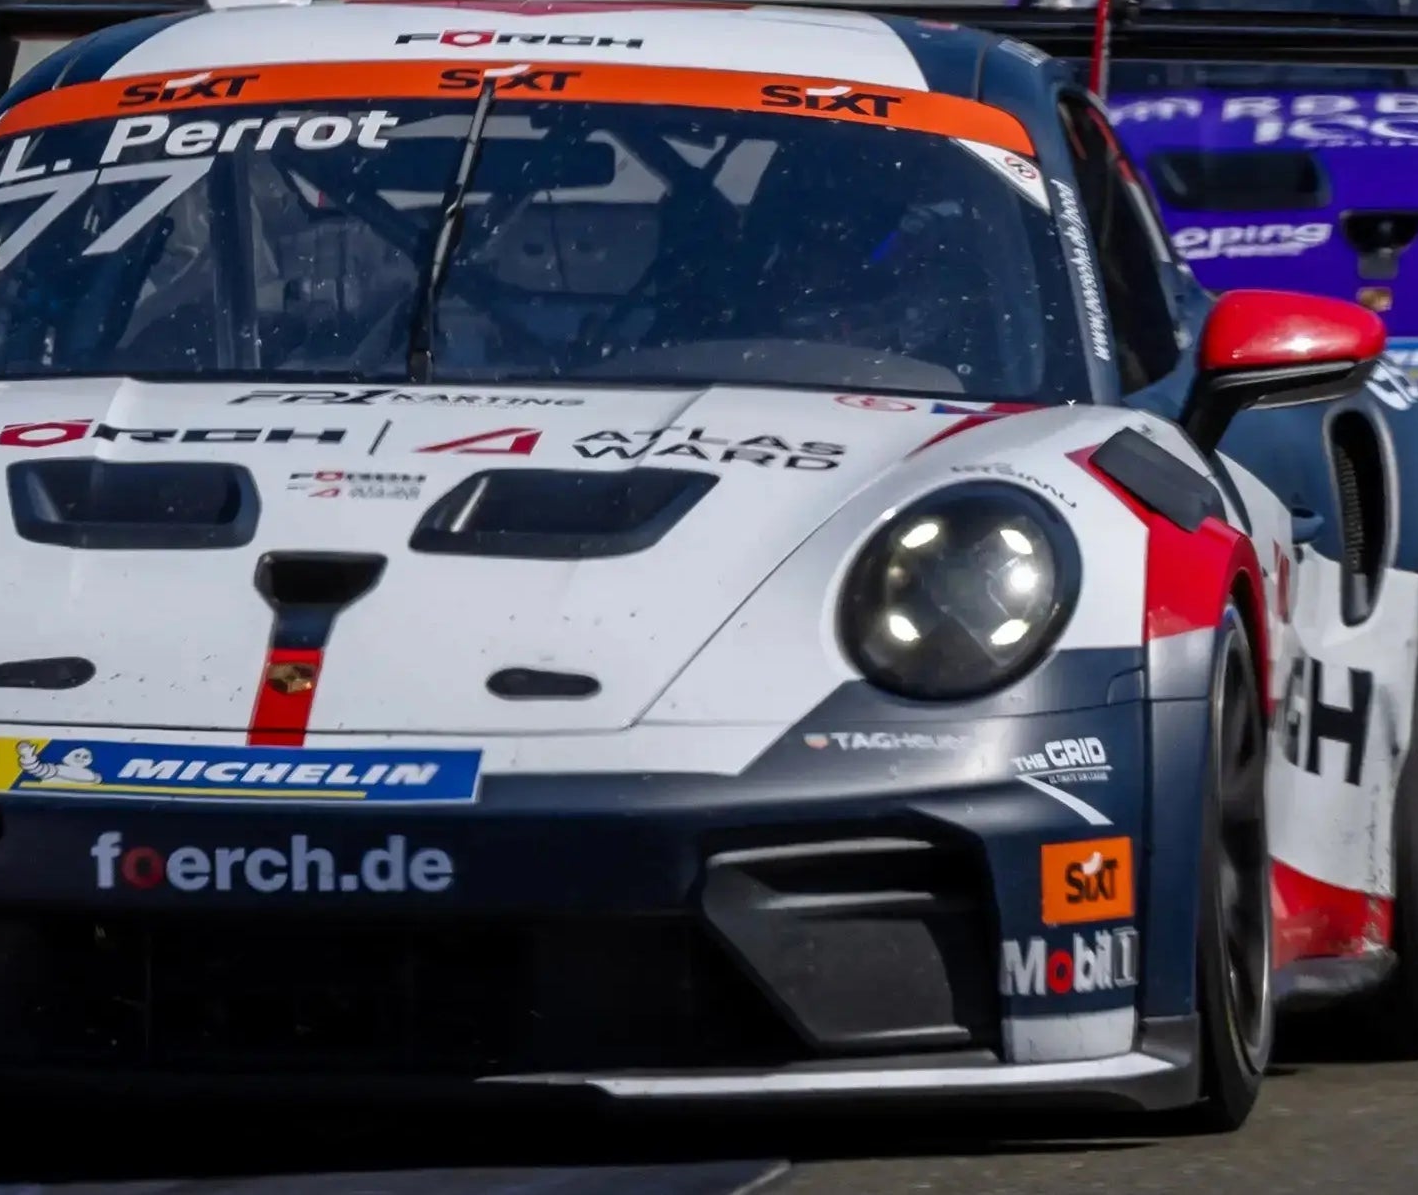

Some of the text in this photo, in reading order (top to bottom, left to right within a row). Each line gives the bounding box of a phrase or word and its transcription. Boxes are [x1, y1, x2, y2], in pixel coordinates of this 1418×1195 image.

[100, 110, 400, 165] Perrot
[572, 442, 841, 472] WARD
[576, 425, 848, 457] ATLAS
[117, 757, 440, 787] MICHELIN
[1011, 736, 1107, 772] THE GRID
[91, 831, 455, 893] foerch.de
[998, 928, 1114, 997] Mobil
